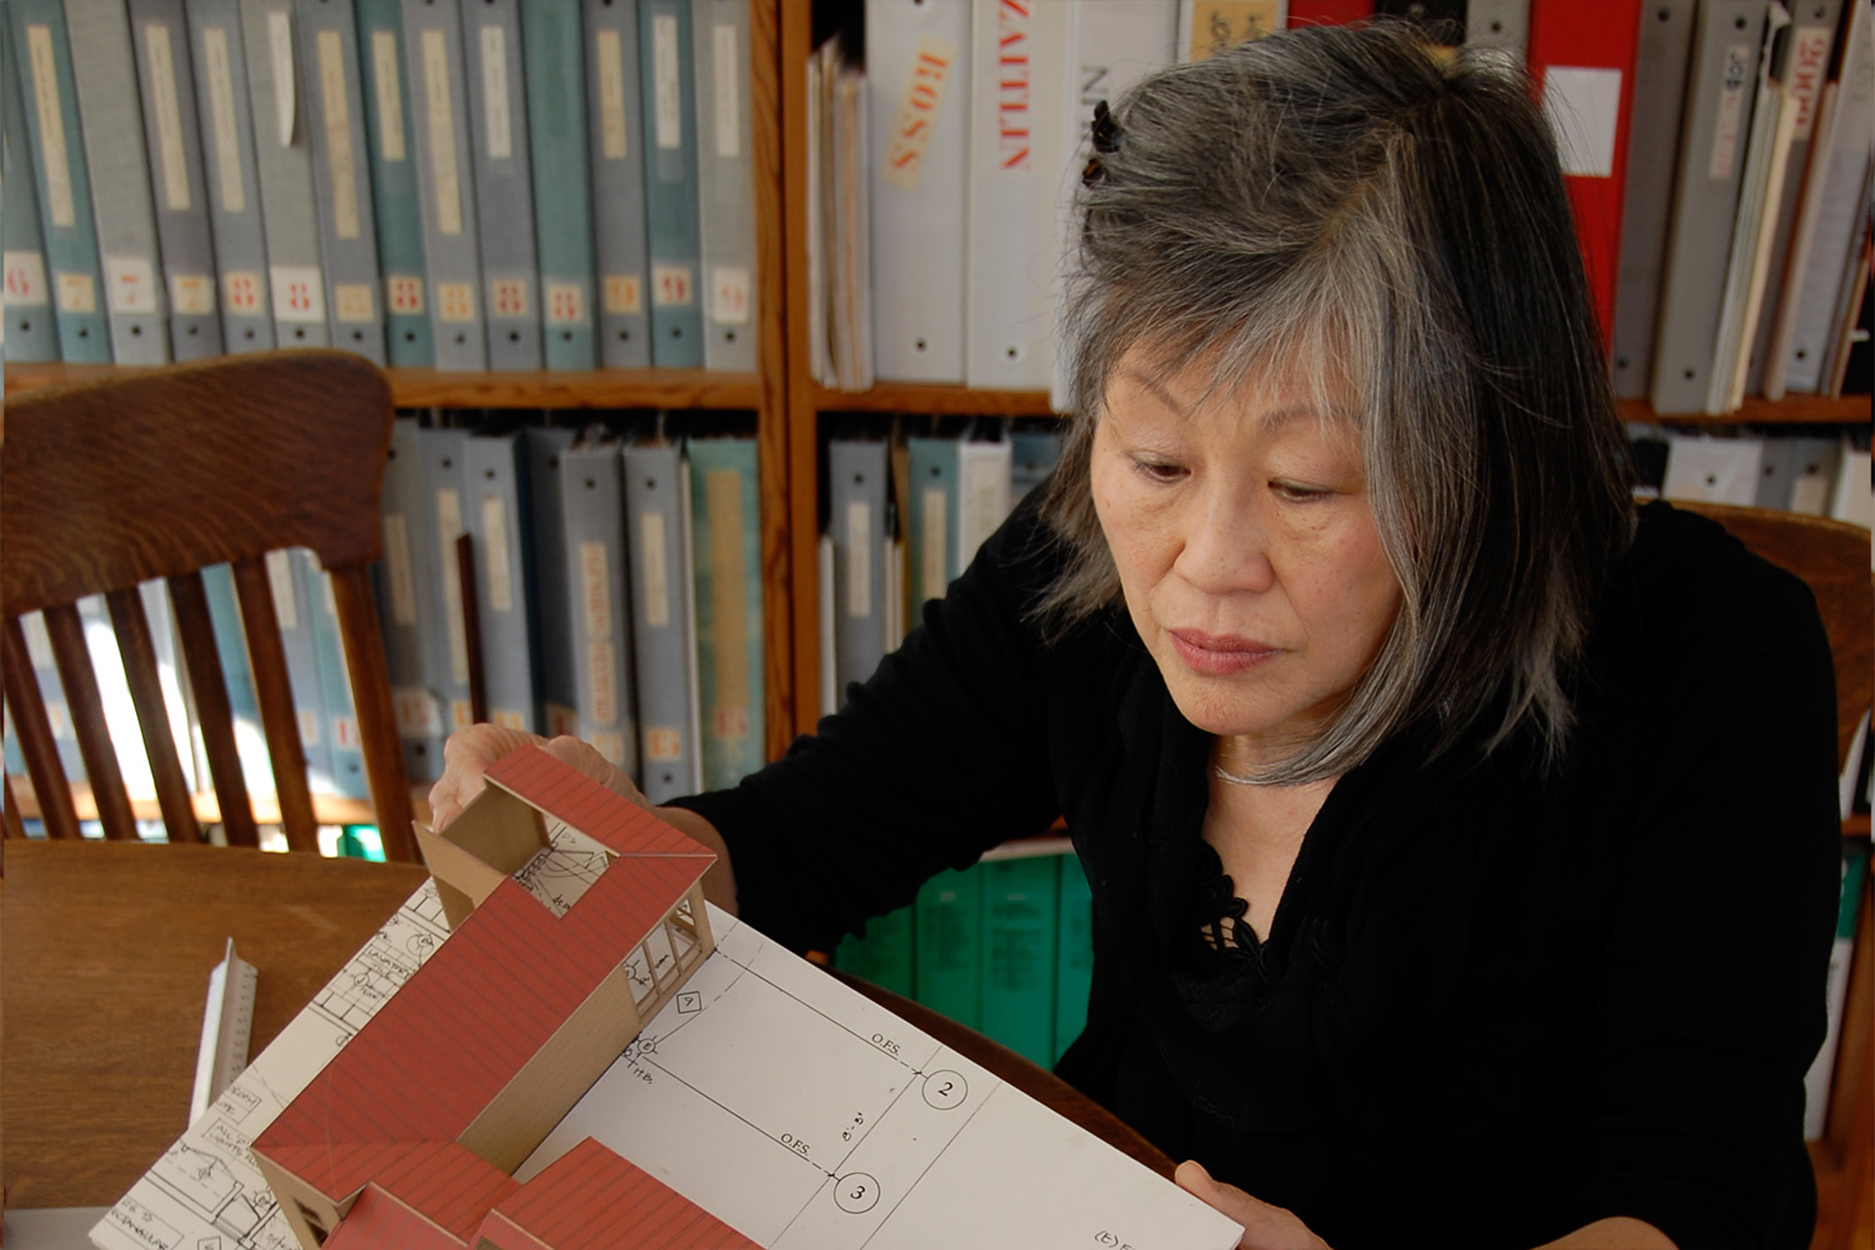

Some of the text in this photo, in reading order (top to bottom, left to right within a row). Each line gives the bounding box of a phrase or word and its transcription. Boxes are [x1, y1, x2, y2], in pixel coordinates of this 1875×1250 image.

[1000, 0, 1030, 169] ZAITLIN
[891, 50, 948, 170] ROSS
[8, 270, 31, 296] 6
[233, 278, 255, 306] 8
[290, 282, 311, 310] 8
[396, 281, 418, 308] 8
[662, 274, 686, 301] 9
[499, 284, 521, 311] 8
[554, 291, 577, 318] 8
[937, 1081, 954, 1097] 2
[849, 1185, 866, 1200] 3
[1094, 1229, 1119, 1249] (E)
